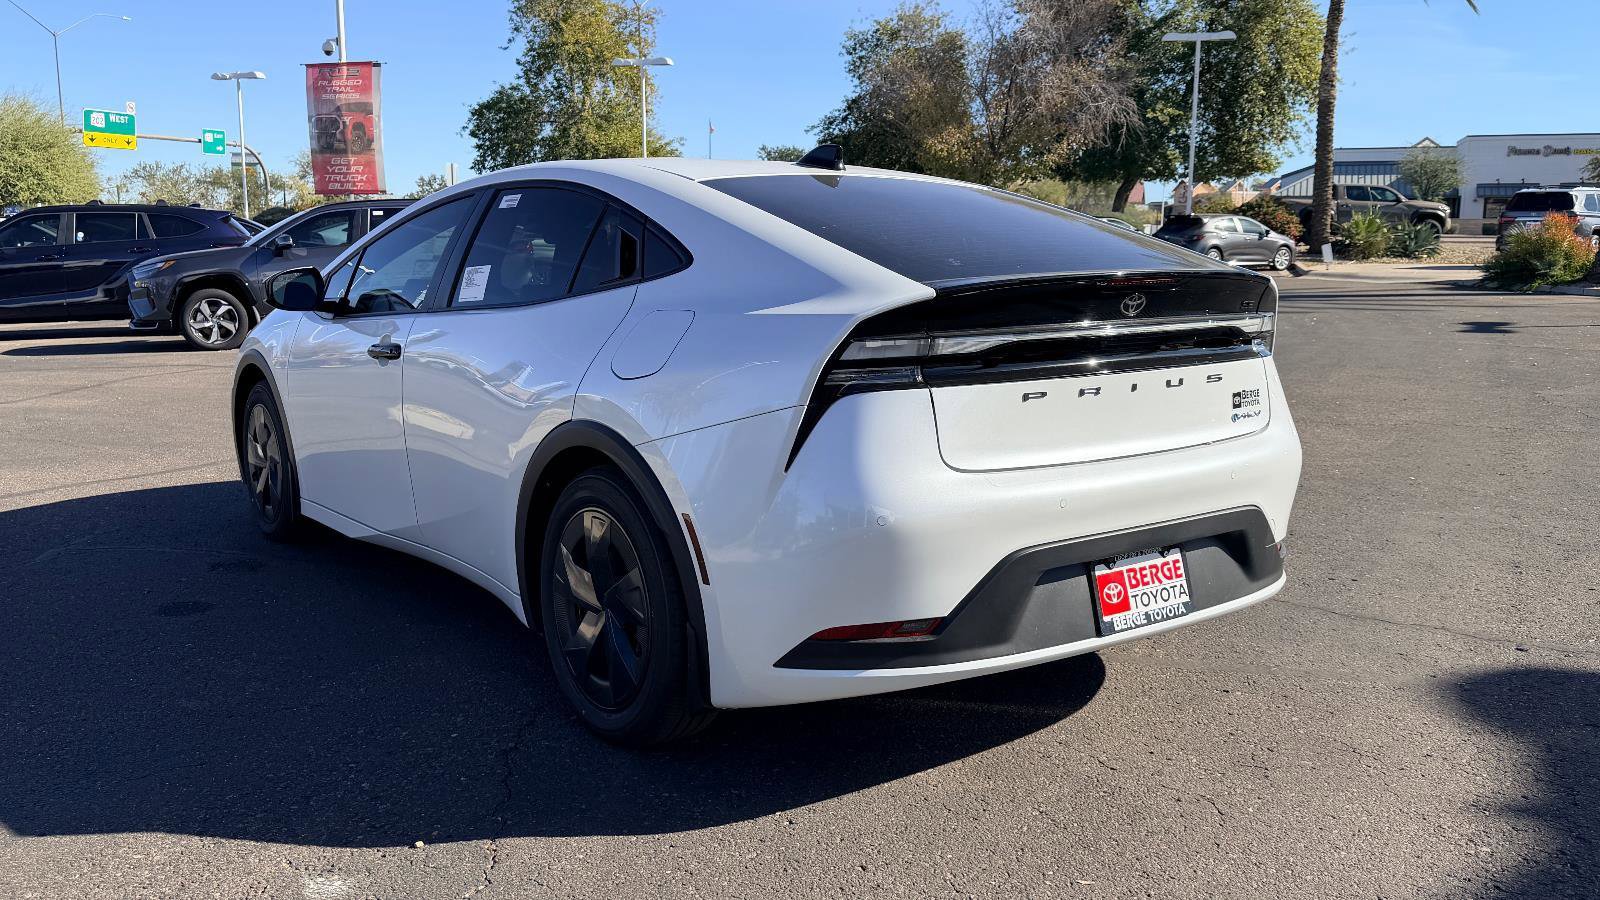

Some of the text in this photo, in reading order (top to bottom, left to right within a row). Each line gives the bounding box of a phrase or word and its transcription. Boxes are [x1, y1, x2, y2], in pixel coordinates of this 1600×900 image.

[321, 92, 361, 100] SERIES
[91, 113, 129, 126] 202 WEST
[331, 157, 358, 165] GET
[326, 165, 363, 173] YOUR
[324, 174, 367, 182] TRUCK
[1022, 373, 1223, 402] PRIUS
[1242, 389, 1260, 399] BERGE
[1242, 399, 1261, 407] TOYOTA
[1126, 559, 1183, 590] BERGE
[1131, 583, 1188, 609] TOYOTA
[1113, 604, 1186, 631] BERGE TOYOTA
